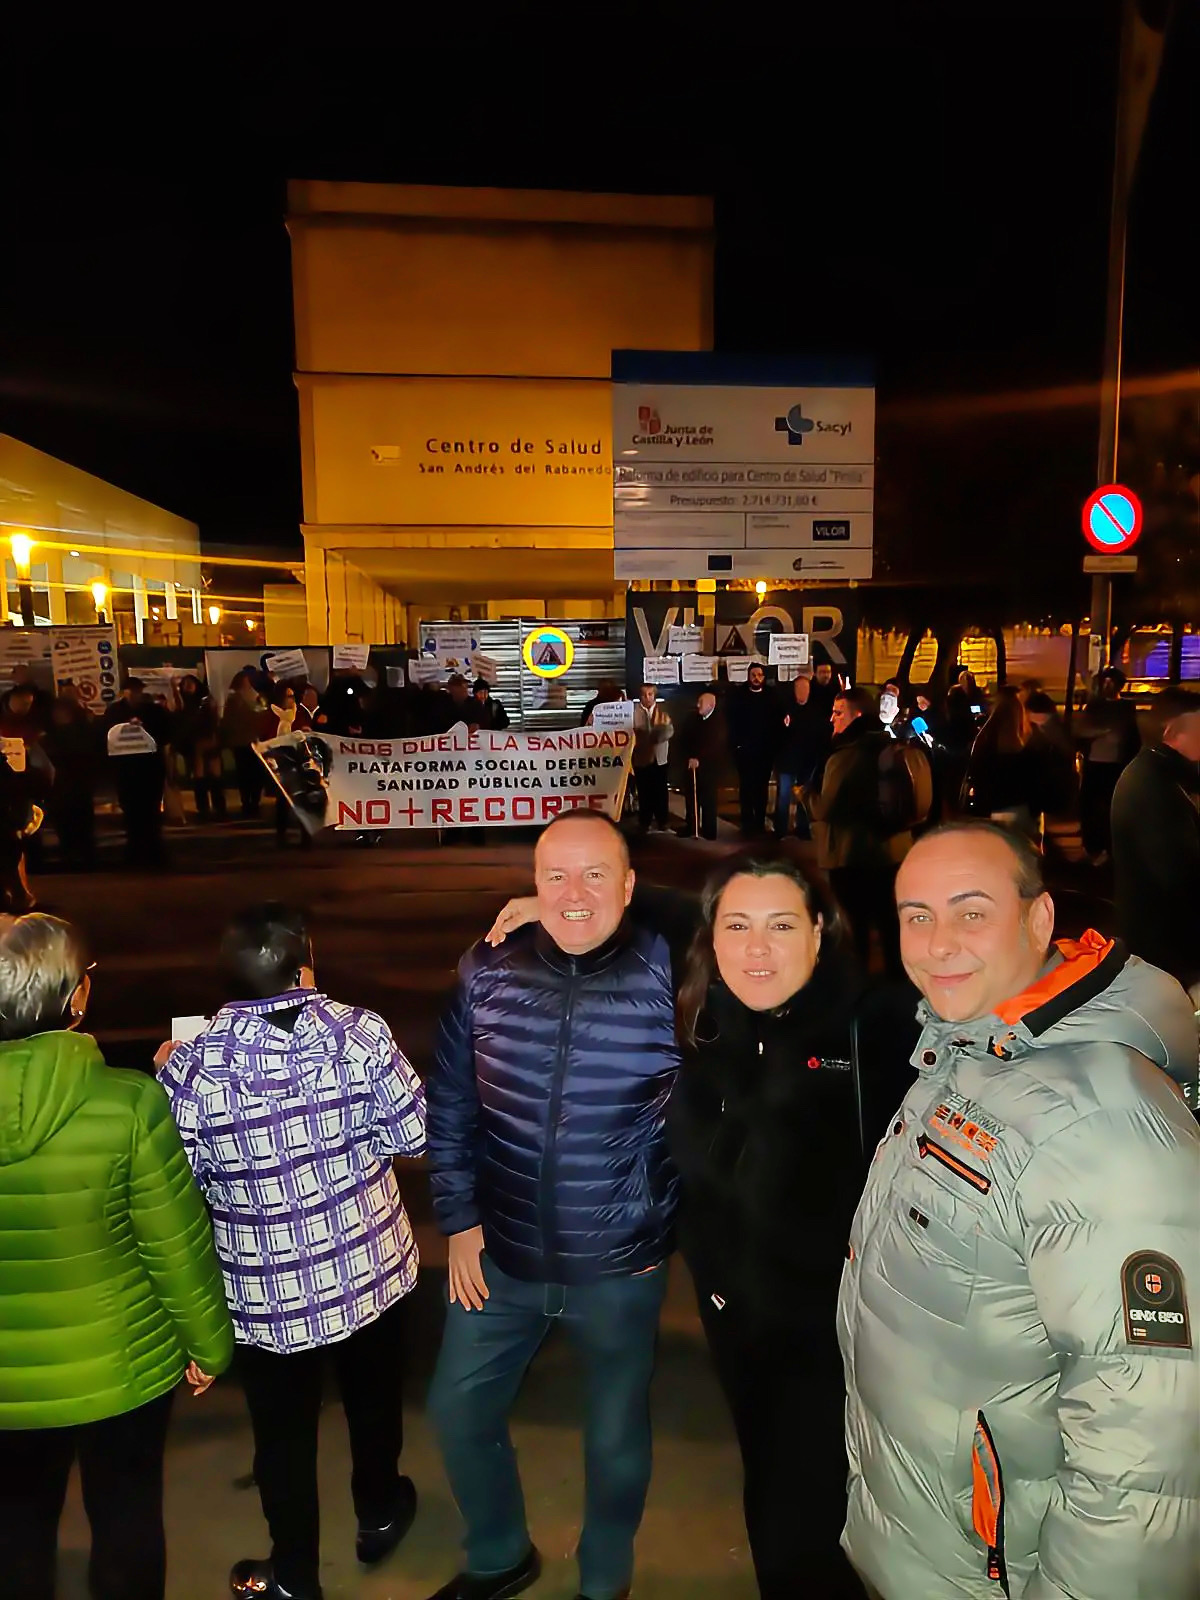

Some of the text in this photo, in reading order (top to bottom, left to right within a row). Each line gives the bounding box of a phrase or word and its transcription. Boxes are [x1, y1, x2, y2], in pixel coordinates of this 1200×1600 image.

[664, 424, 713, 434] Junta de
[816, 420, 852, 435] Sacyl
[426, 437, 601, 455] Centro de Salud
[632, 434, 714, 447] Castilla y León
[418, 462, 612, 475] San Andrés del Rabanedo
[666, 468, 680, 482] de
[720, 471, 744, 483] para
[747, 469, 781, 482] Centro
[783, 469, 798, 482] de
[799, 469, 827, 483] Salud
[815, 526, 846, 536] VILOR
[339, 730, 630, 756] NOS DUELE LA SANIDAD
[348, 755, 624, 774] PLATAFORMA SOCIAL DEFENSA
[377, 772, 596, 791] SANIDAD PÚBLICA LEÓN
[338, 799, 391, 825] NO
[431, 794, 619, 823] RECORTE
